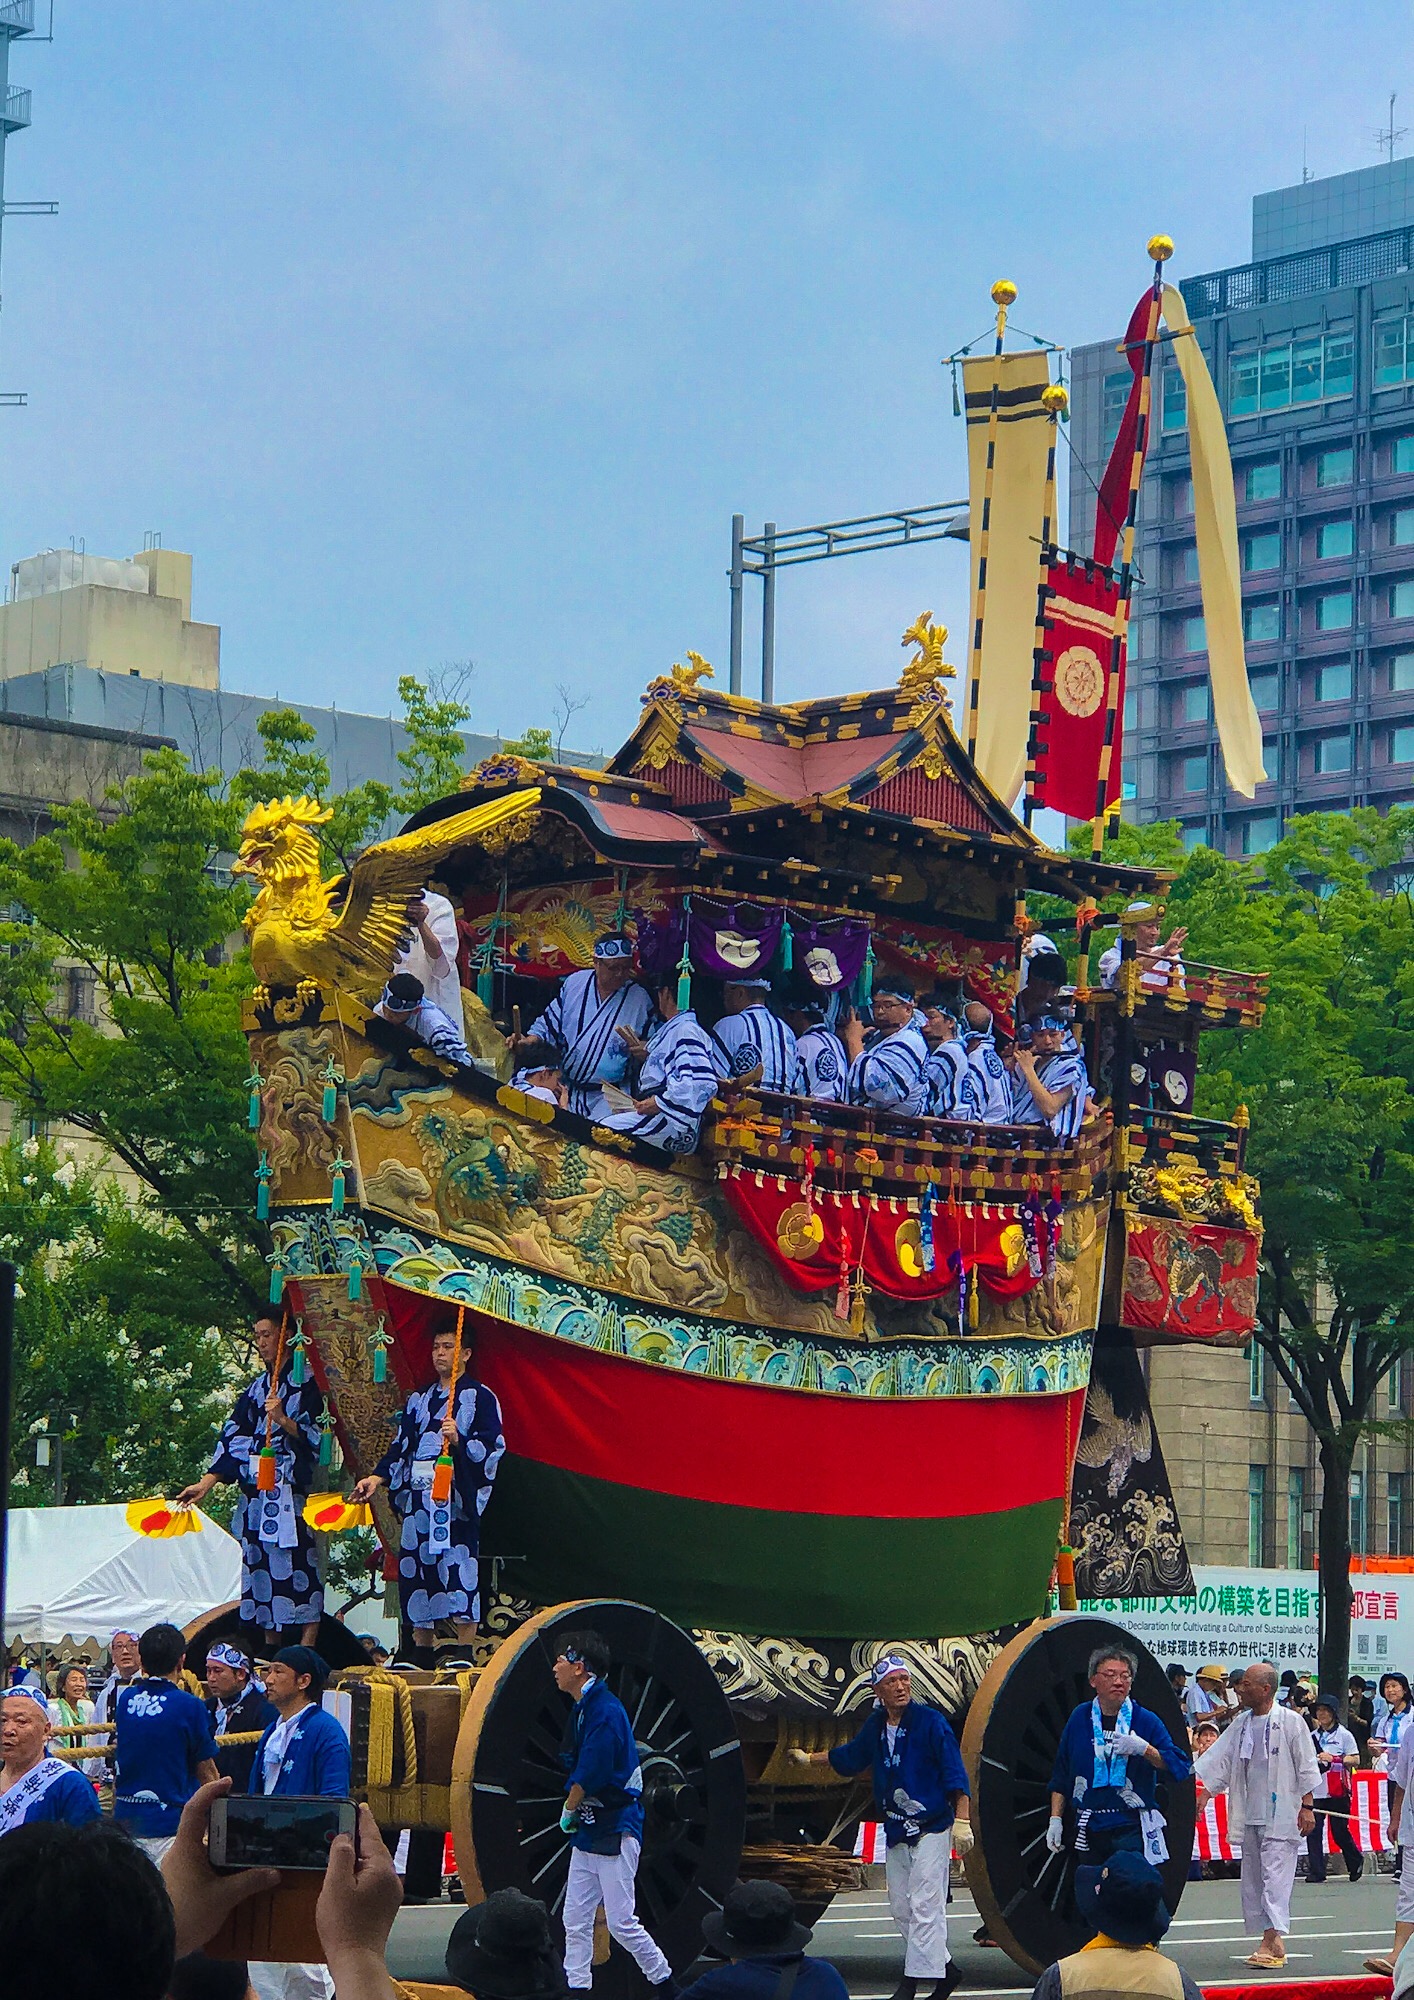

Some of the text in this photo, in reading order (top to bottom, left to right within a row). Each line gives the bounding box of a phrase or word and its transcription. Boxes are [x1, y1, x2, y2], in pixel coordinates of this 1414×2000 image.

[1128, 1621, 1169, 1632] Declaration
[1170, 1621, 1182, 1632] for
[1183, 1621, 1221, 1634] Cultivating
[1228, 1623, 1254, 1633] Culture
[1255, 1623, 1263, 1633] of
[1264, 1623, 1303, 1635] Sustainable
[1304, 1624, 1319, 1635] Citie
[1147, 1640, 1318, 1659] な地球環境を将来の世代に引き継ぐた
